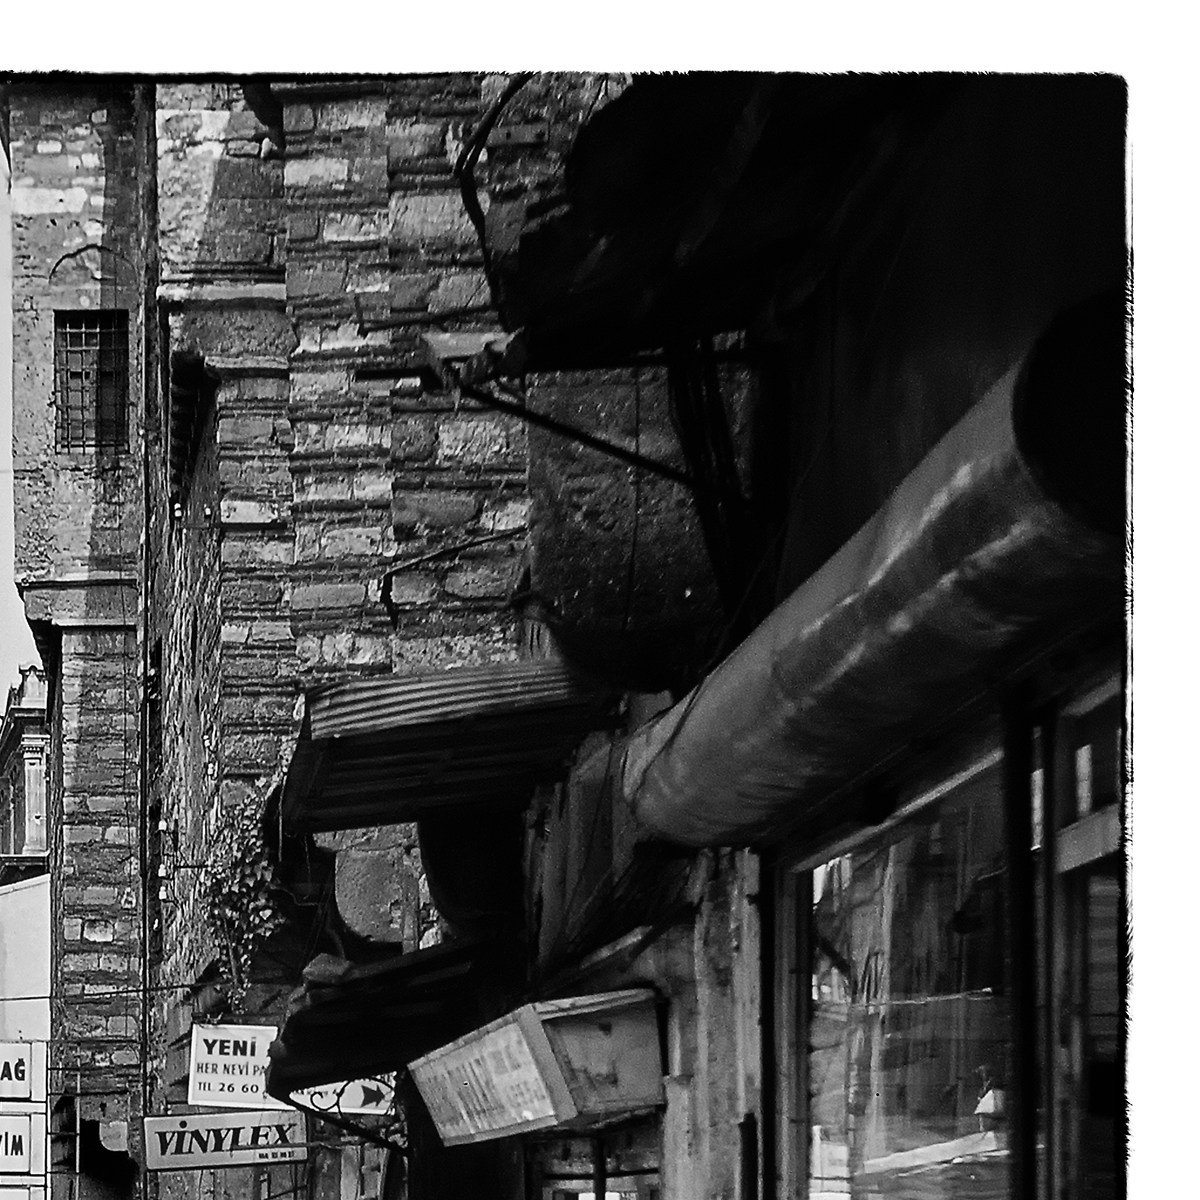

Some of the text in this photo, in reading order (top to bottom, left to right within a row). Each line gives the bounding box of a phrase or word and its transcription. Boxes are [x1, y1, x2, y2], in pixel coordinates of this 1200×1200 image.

[203, 1036, 257, 1057] YENİ
[196, 1063, 218, 1074] HER
[219, 1082, 235, 1093] 26
[241, 1083, 259, 1094] 60
